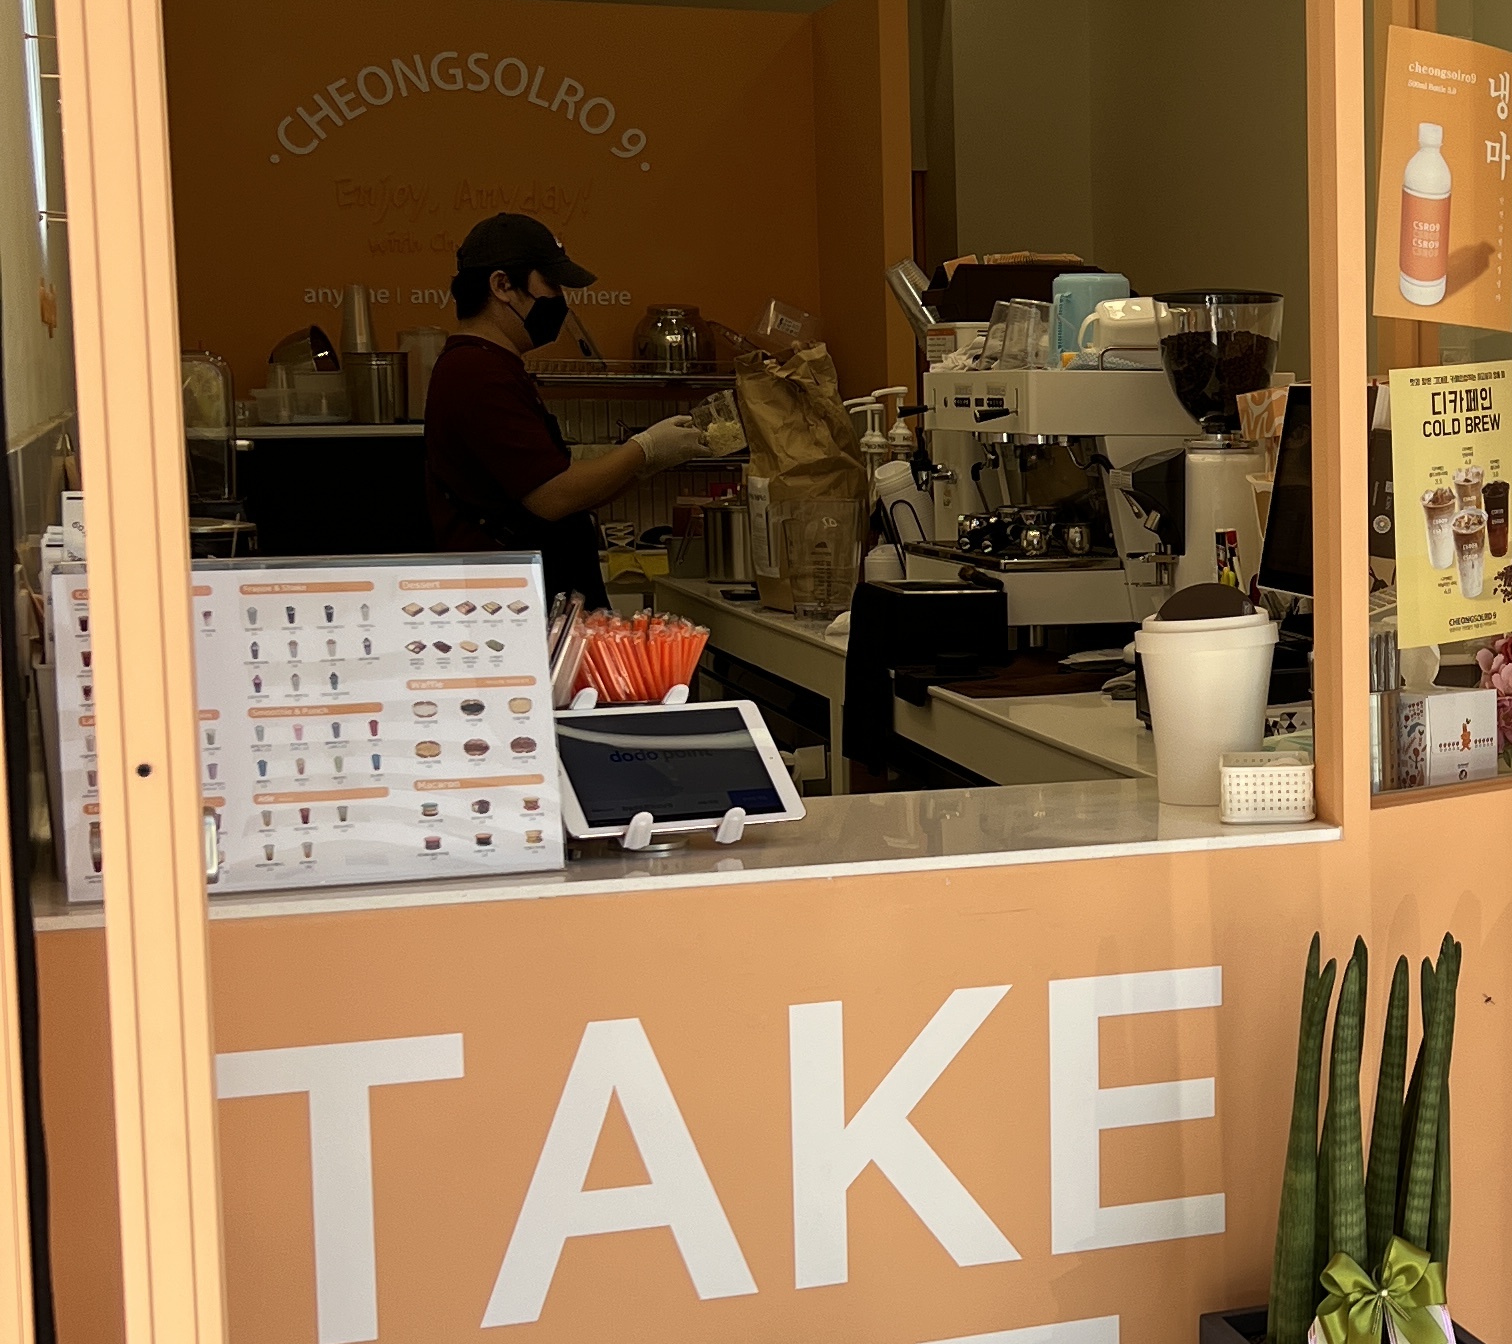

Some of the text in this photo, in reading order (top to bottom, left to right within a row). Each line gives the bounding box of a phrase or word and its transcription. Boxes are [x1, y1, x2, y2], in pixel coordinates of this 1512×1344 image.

[1408, 61, 1477, 84] cheongsolro9
[277, 51, 648, 158] CHEONGSOLRO 9
[304, 287, 389, 309] anyne
[1431, 386, 1493, 415] 디카페인
[1422, 413, 1501, 437] COLD BREW
[402, 581, 441, 589] Dessert
[411, 681, 445, 689] Waffle
[609, 750, 658, 763] dodo
[417, 781, 460, 789] Macaron
